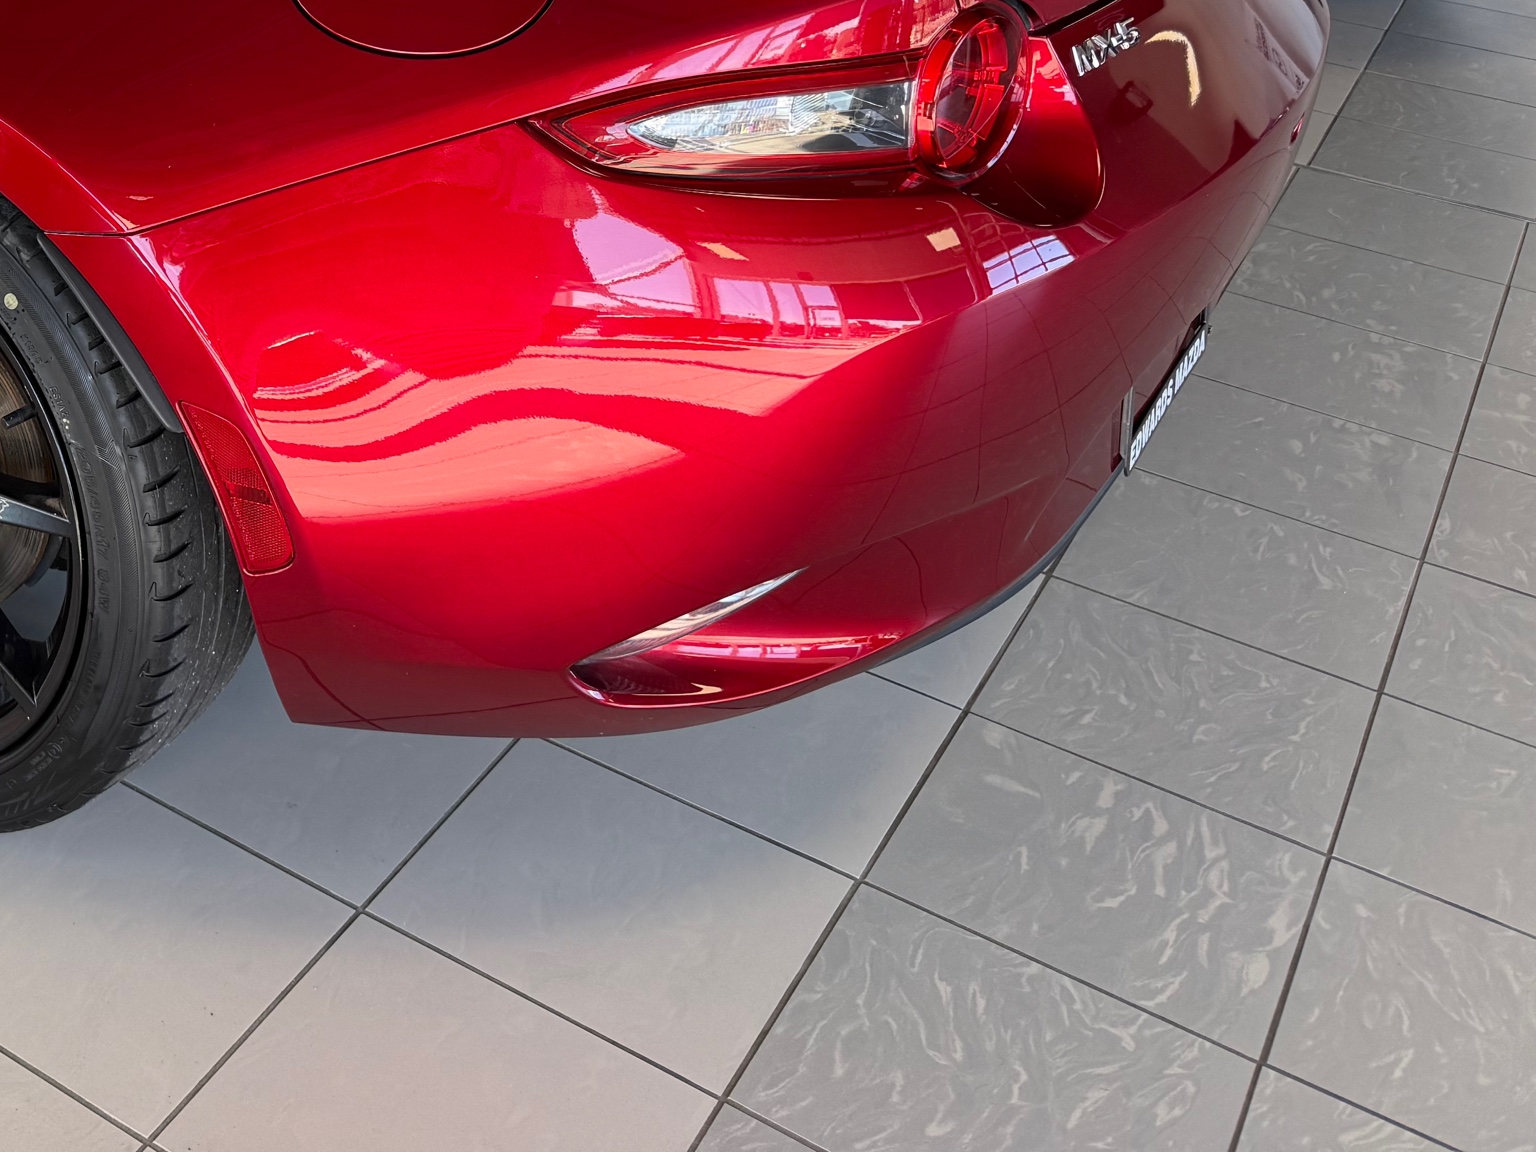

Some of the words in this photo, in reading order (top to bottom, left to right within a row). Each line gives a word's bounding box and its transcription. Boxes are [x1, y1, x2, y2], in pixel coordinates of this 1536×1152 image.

[1071, 17, 1141, 77] MX-5
[1129, 378, 1174, 471] EDWARDS
[1174, 329, 1206, 394] MAZDA
